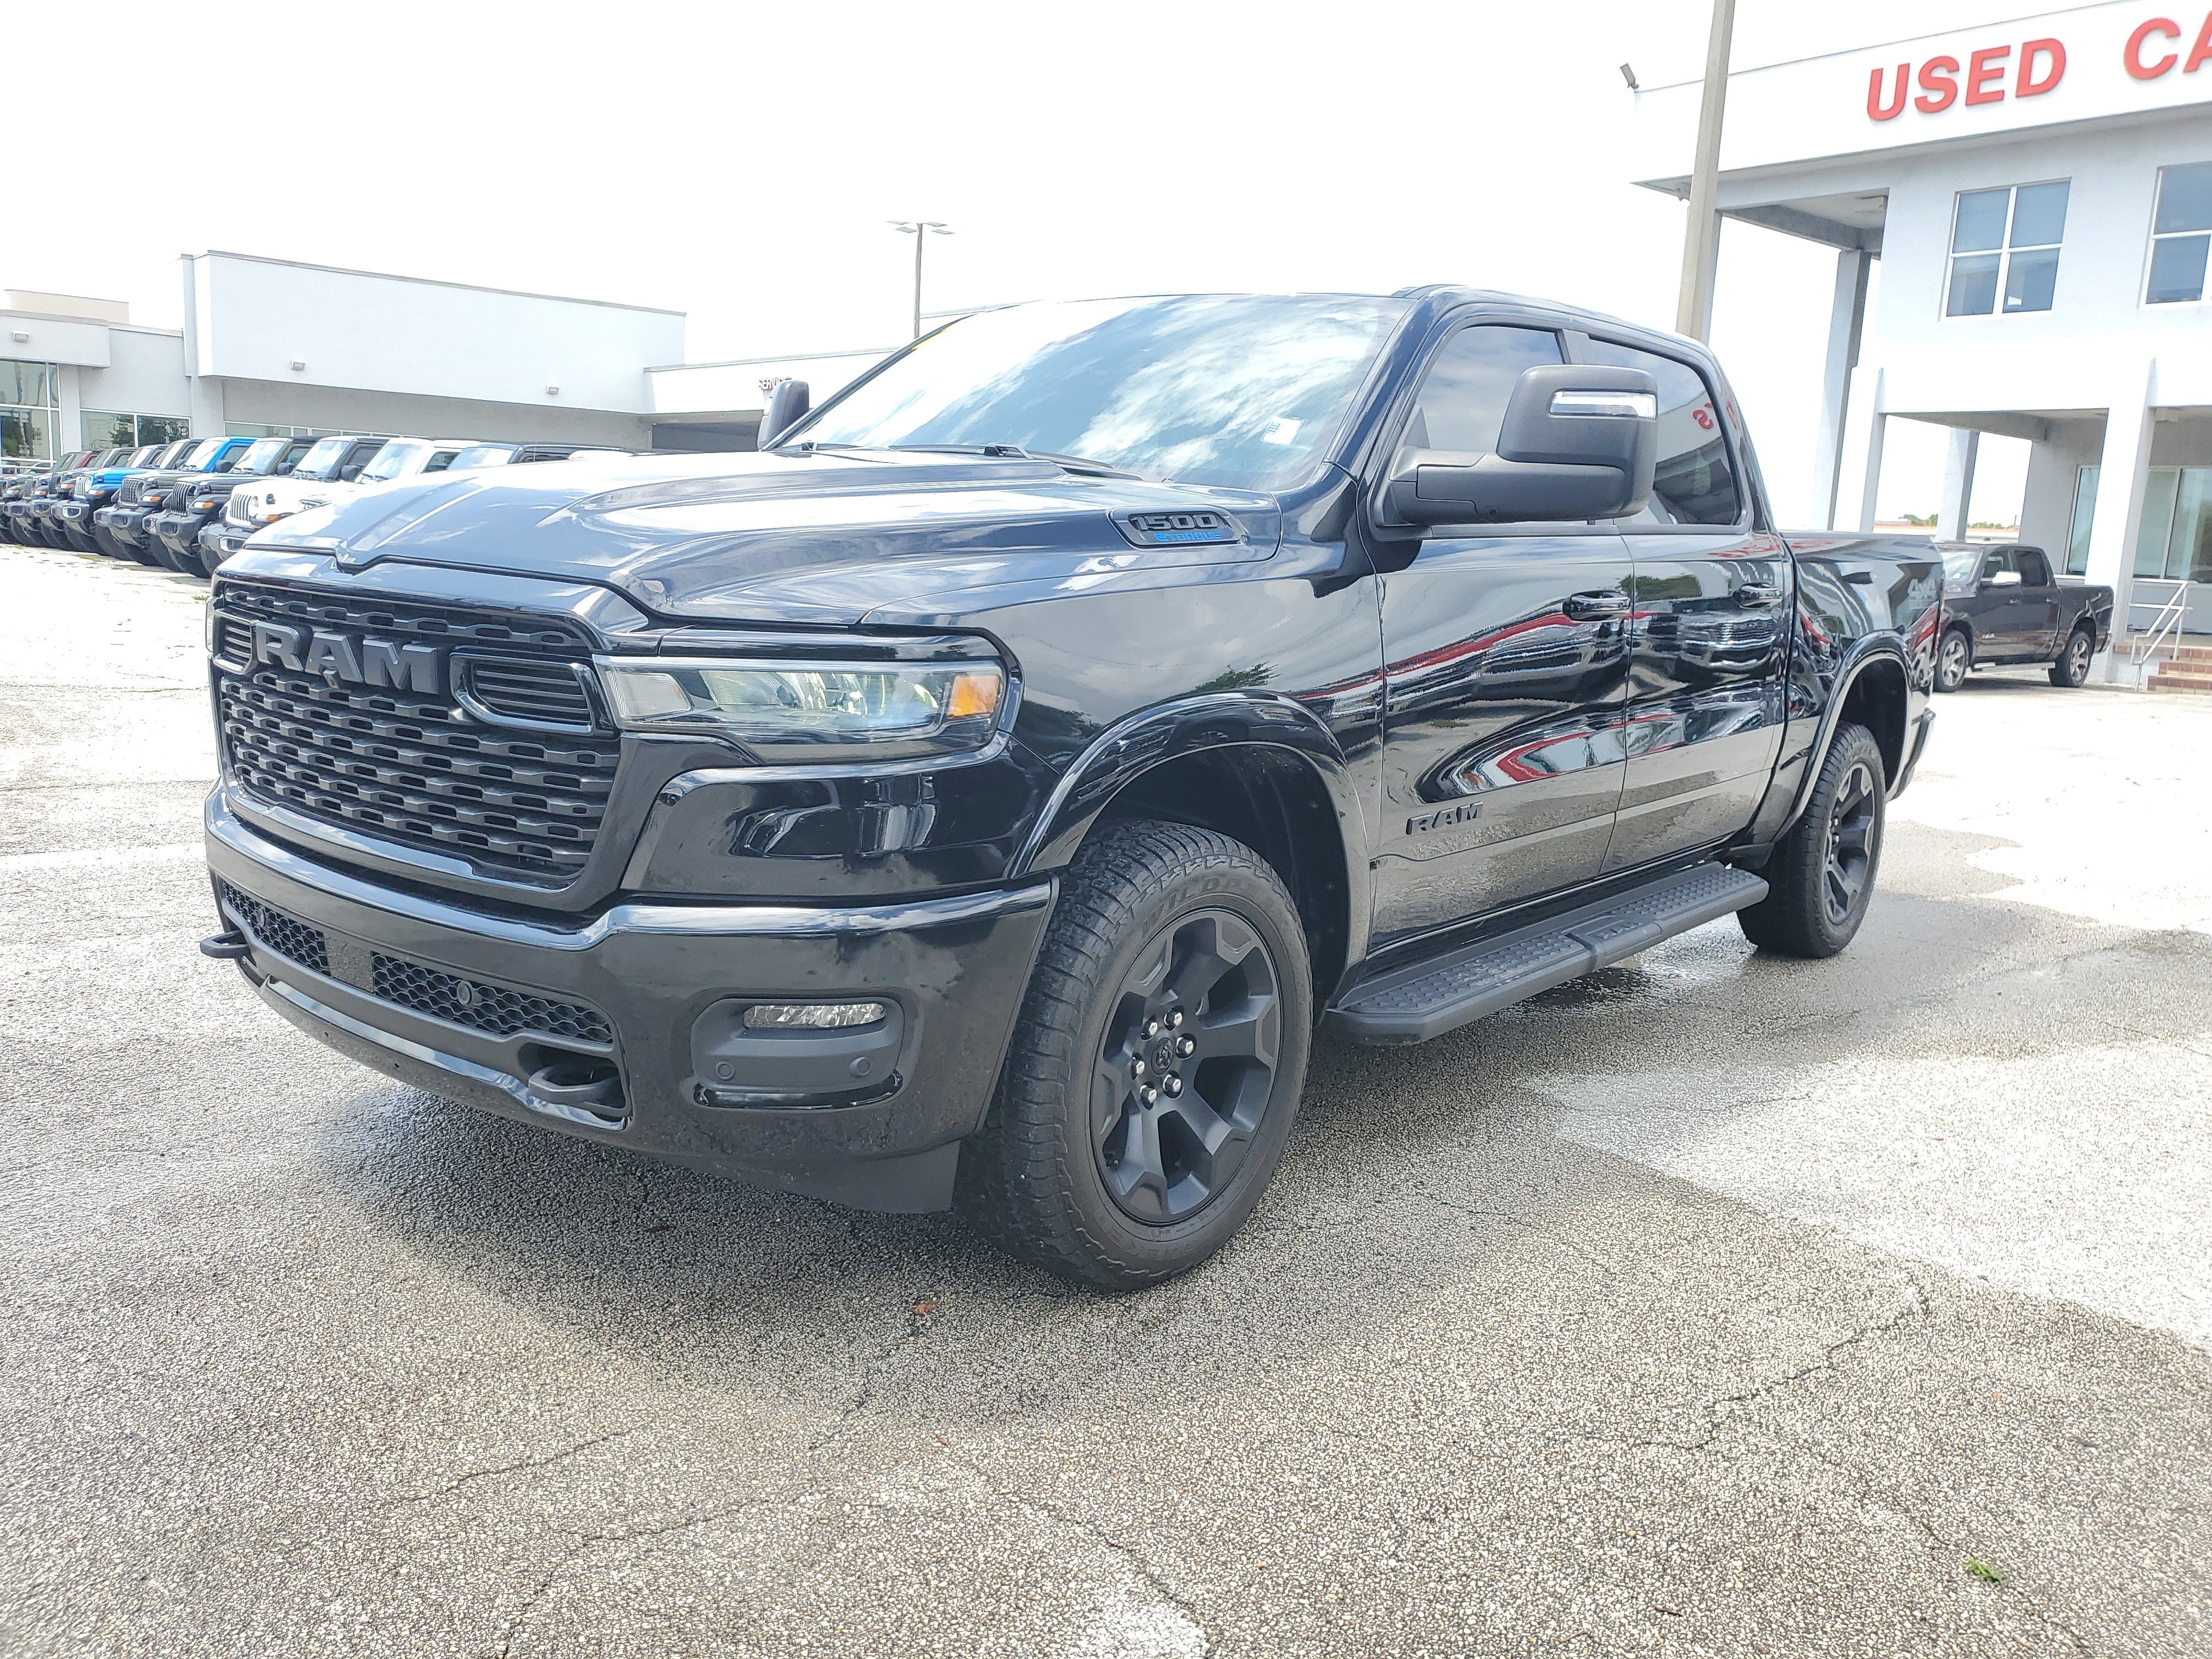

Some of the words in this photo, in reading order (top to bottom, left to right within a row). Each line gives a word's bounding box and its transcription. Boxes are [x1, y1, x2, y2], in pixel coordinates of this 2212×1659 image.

[1867, 38, 2067, 121] USED
[758, 376, 792, 390] SERVI
[1131, 514, 1219, 531] 1500
[255, 621, 438, 694] RAM
[1405, 801, 1483, 836] RAM
